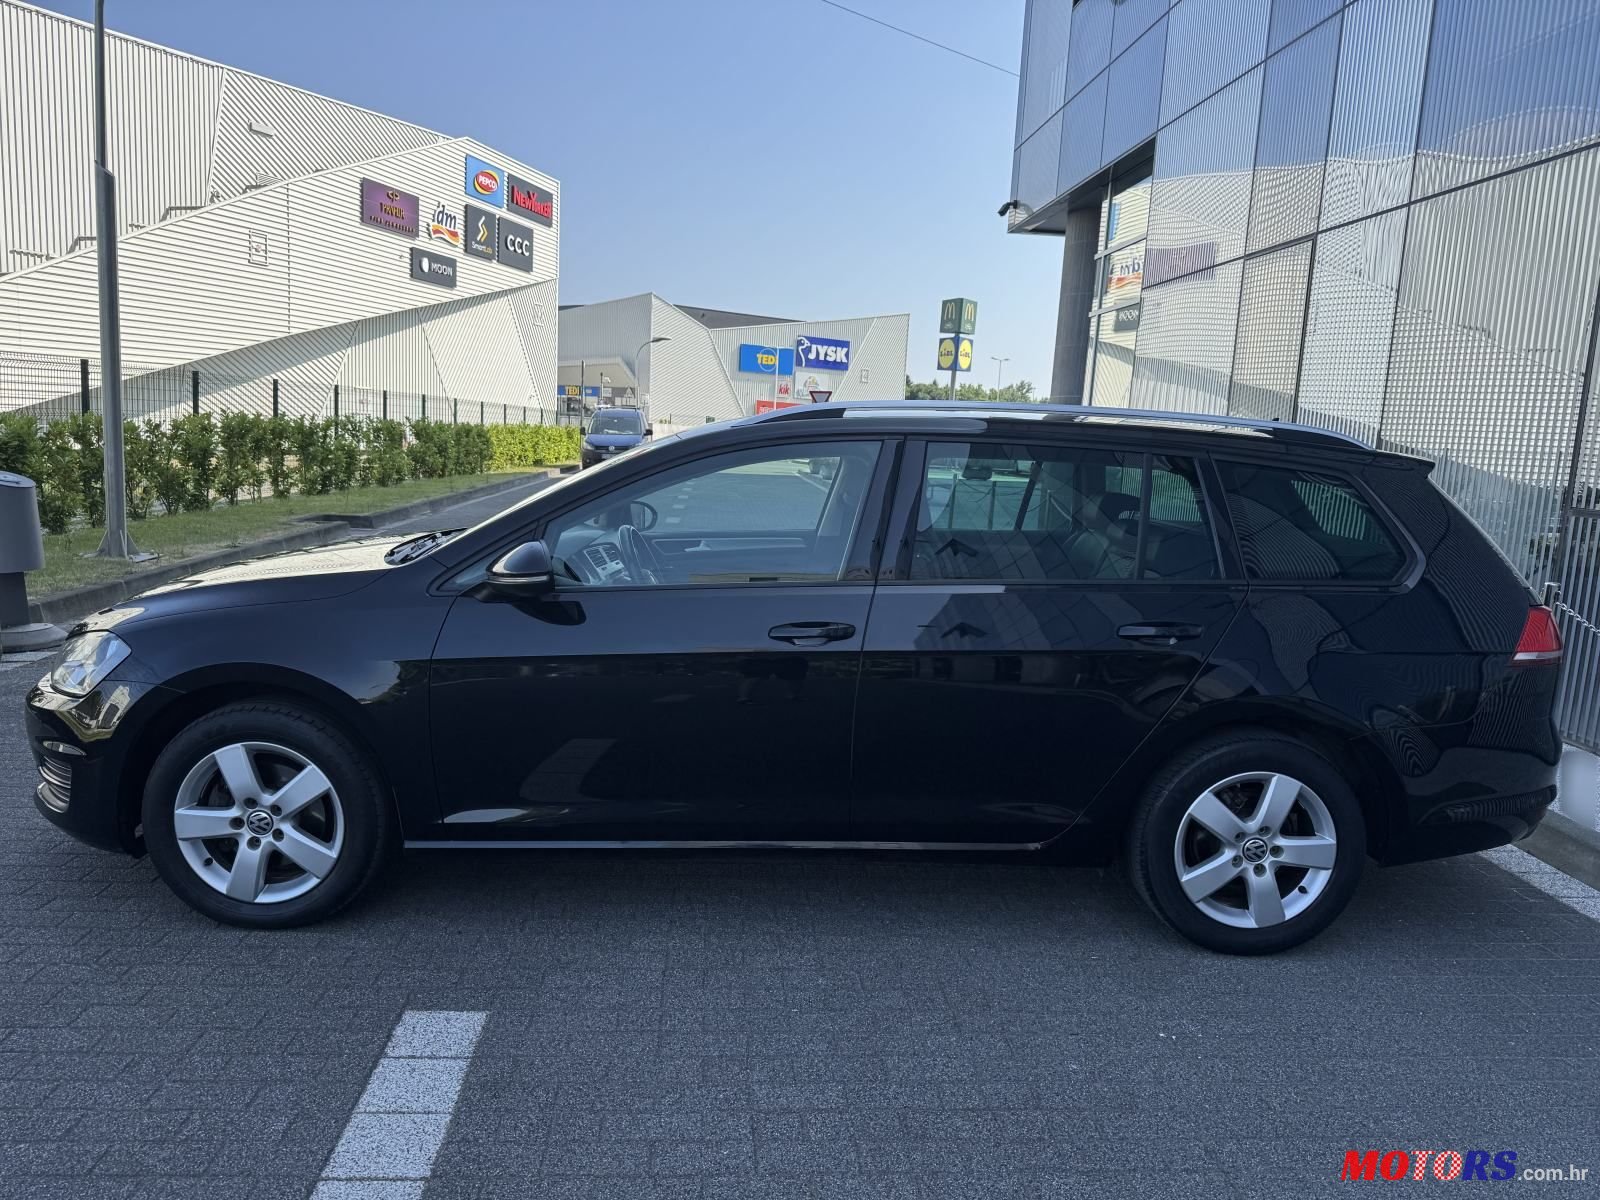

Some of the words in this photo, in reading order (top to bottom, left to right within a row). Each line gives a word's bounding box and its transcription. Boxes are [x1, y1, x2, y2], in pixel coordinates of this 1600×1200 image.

[478, 175, 496, 188] PEPCO
[436, 205, 457, 230] dm
[506, 235, 530, 257] CCC
[431, 263, 453, 277] MOON
[808, 344, 848, 363] JYSK
[778, 383, 790, 395] kik
